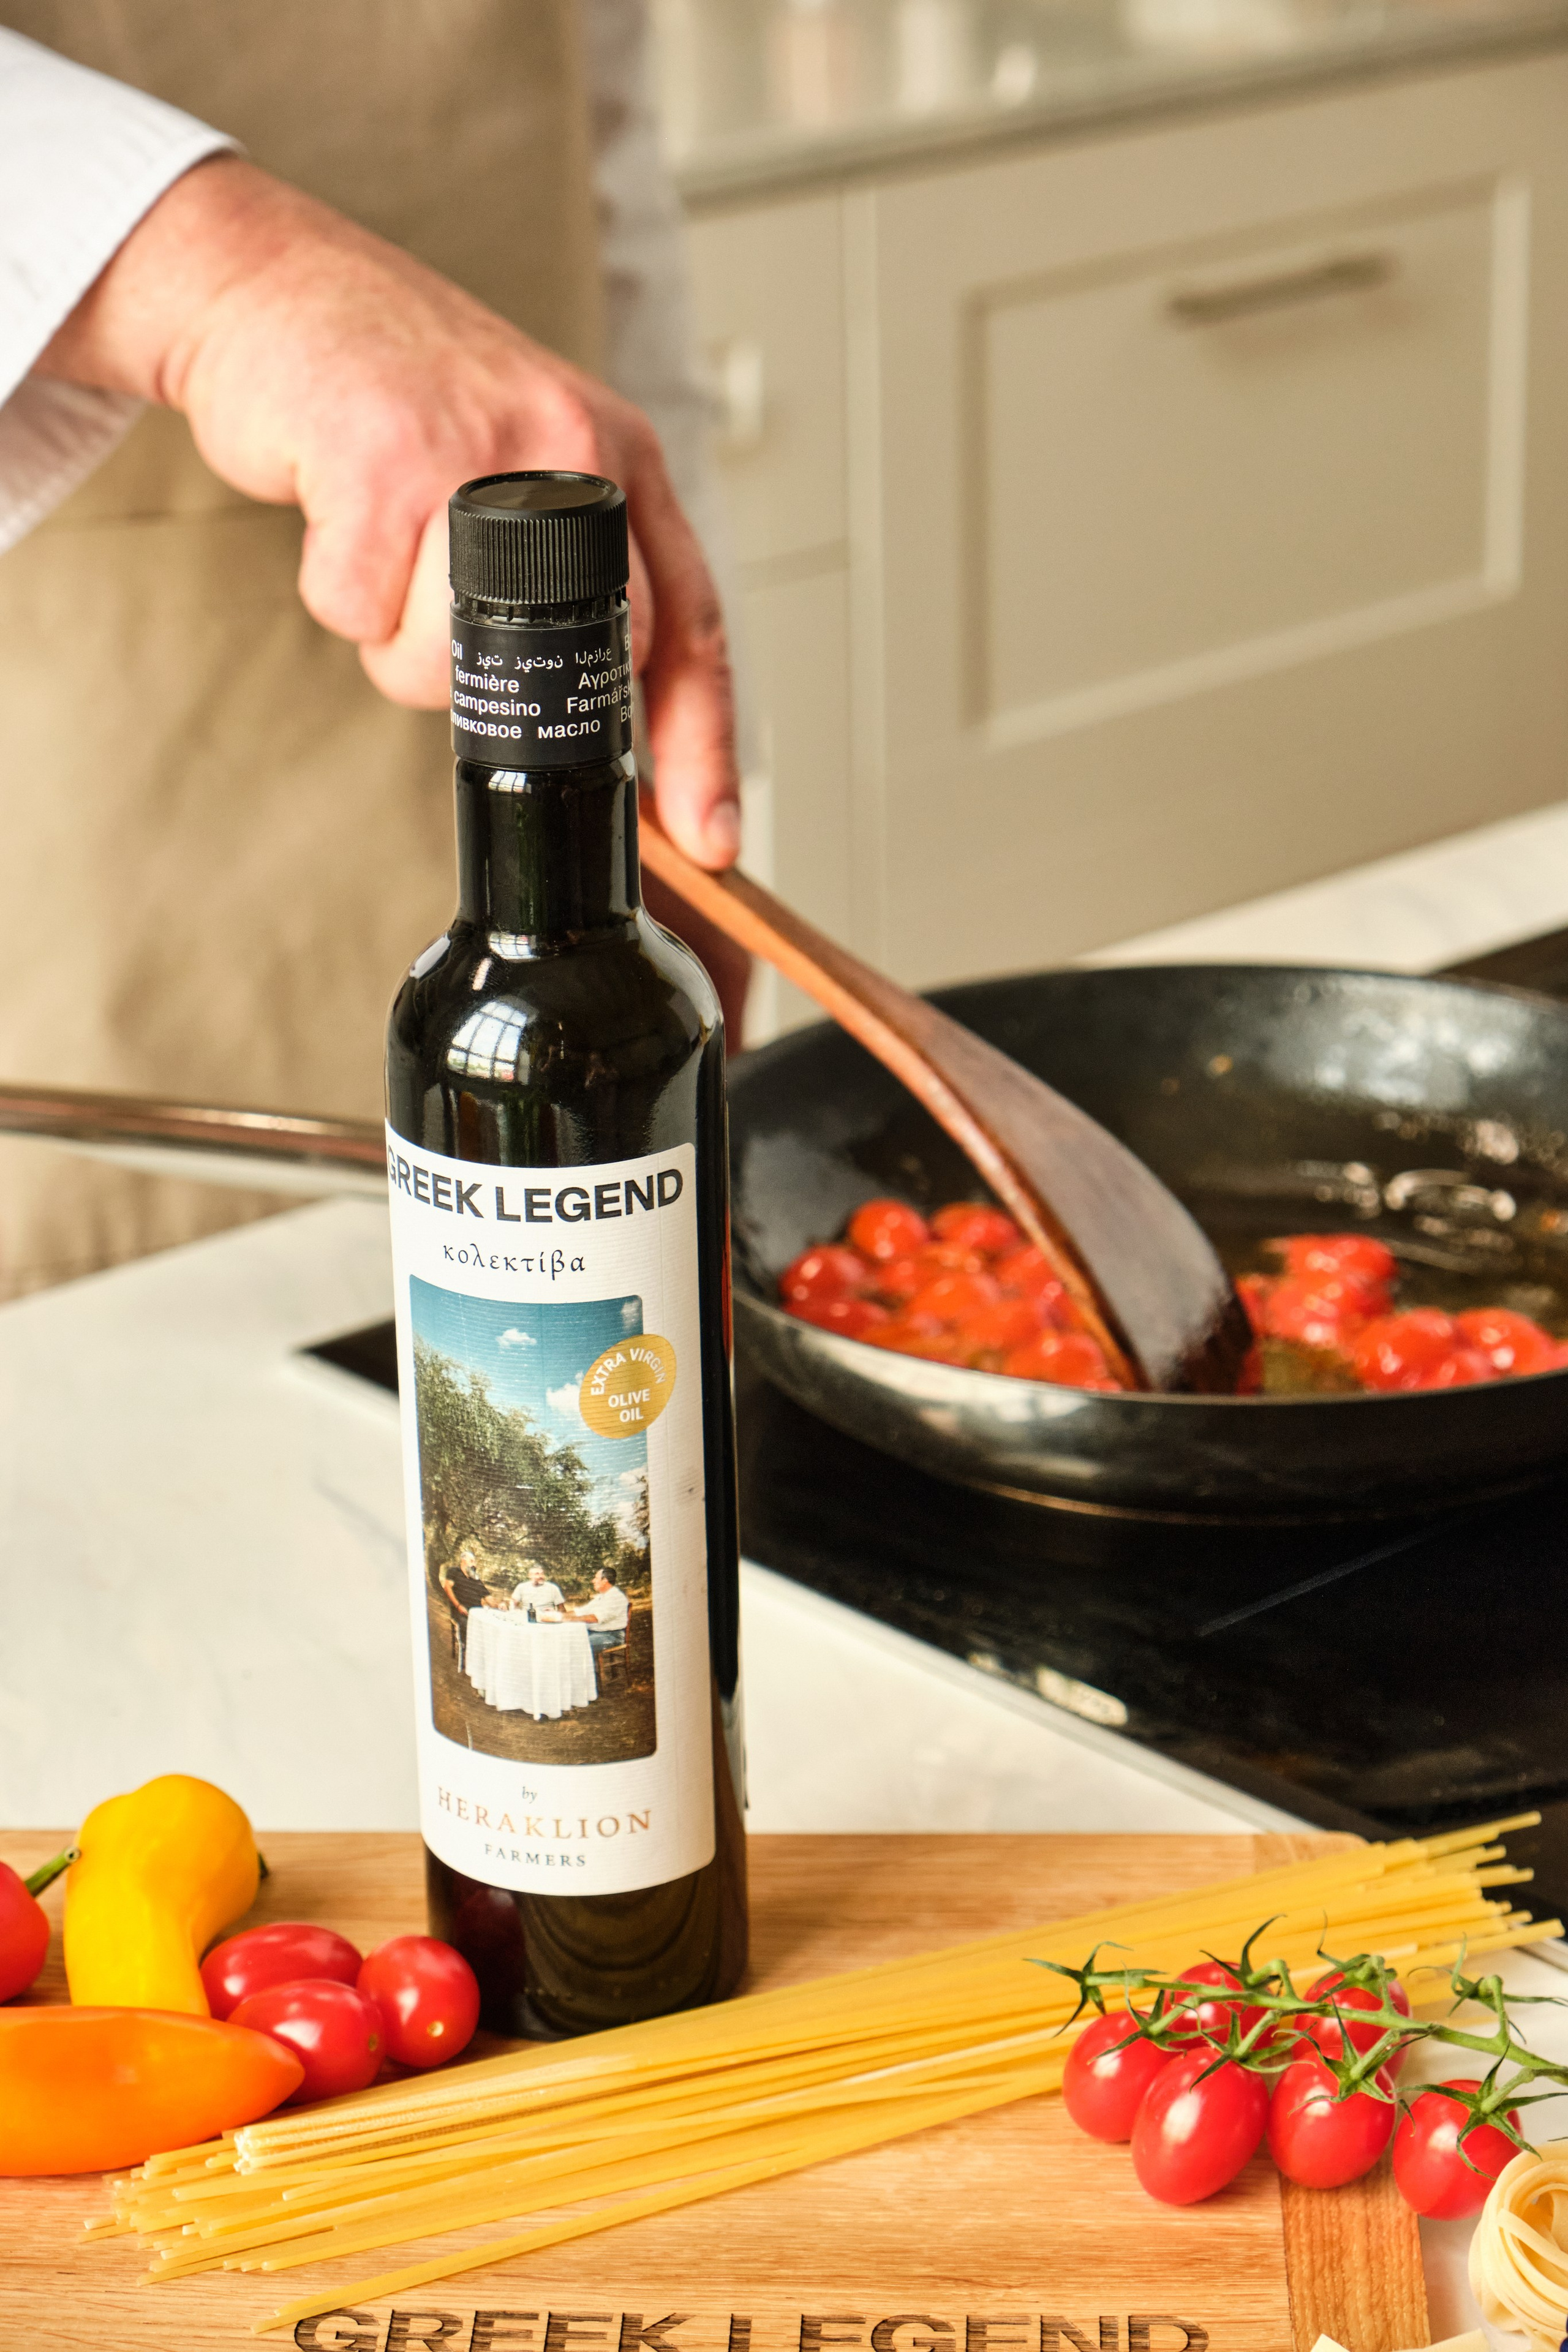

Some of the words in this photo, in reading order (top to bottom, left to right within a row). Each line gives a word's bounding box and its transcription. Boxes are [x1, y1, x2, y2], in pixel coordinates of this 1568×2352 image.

[451, 639, 463, 660] Oil
[454, 665, 520, 693] fermière
[453, 690, 541, 717] campesino
[537, 719, 601, 739] масло
[388, 1144, 484, 1219] GREEK
[495, 1168, 684, 1223] LEGEND
[443, 1243, 586, 1281] κολεκτίβα
[590, 1352, 627, 1396] EXTRA
[629, 1348, 666, 1385] VIRGIN
[608, 1388, 650, 1408] OLIVE
[619, 1408, 644, 1423] OIL
[521, 1785, 538, 1804] by
[438, 1786, 652, 1839] HERAKLION
[484, 1844, 586, 1867] FARMERS
[294, 2308, 697, 2352] GREEK
